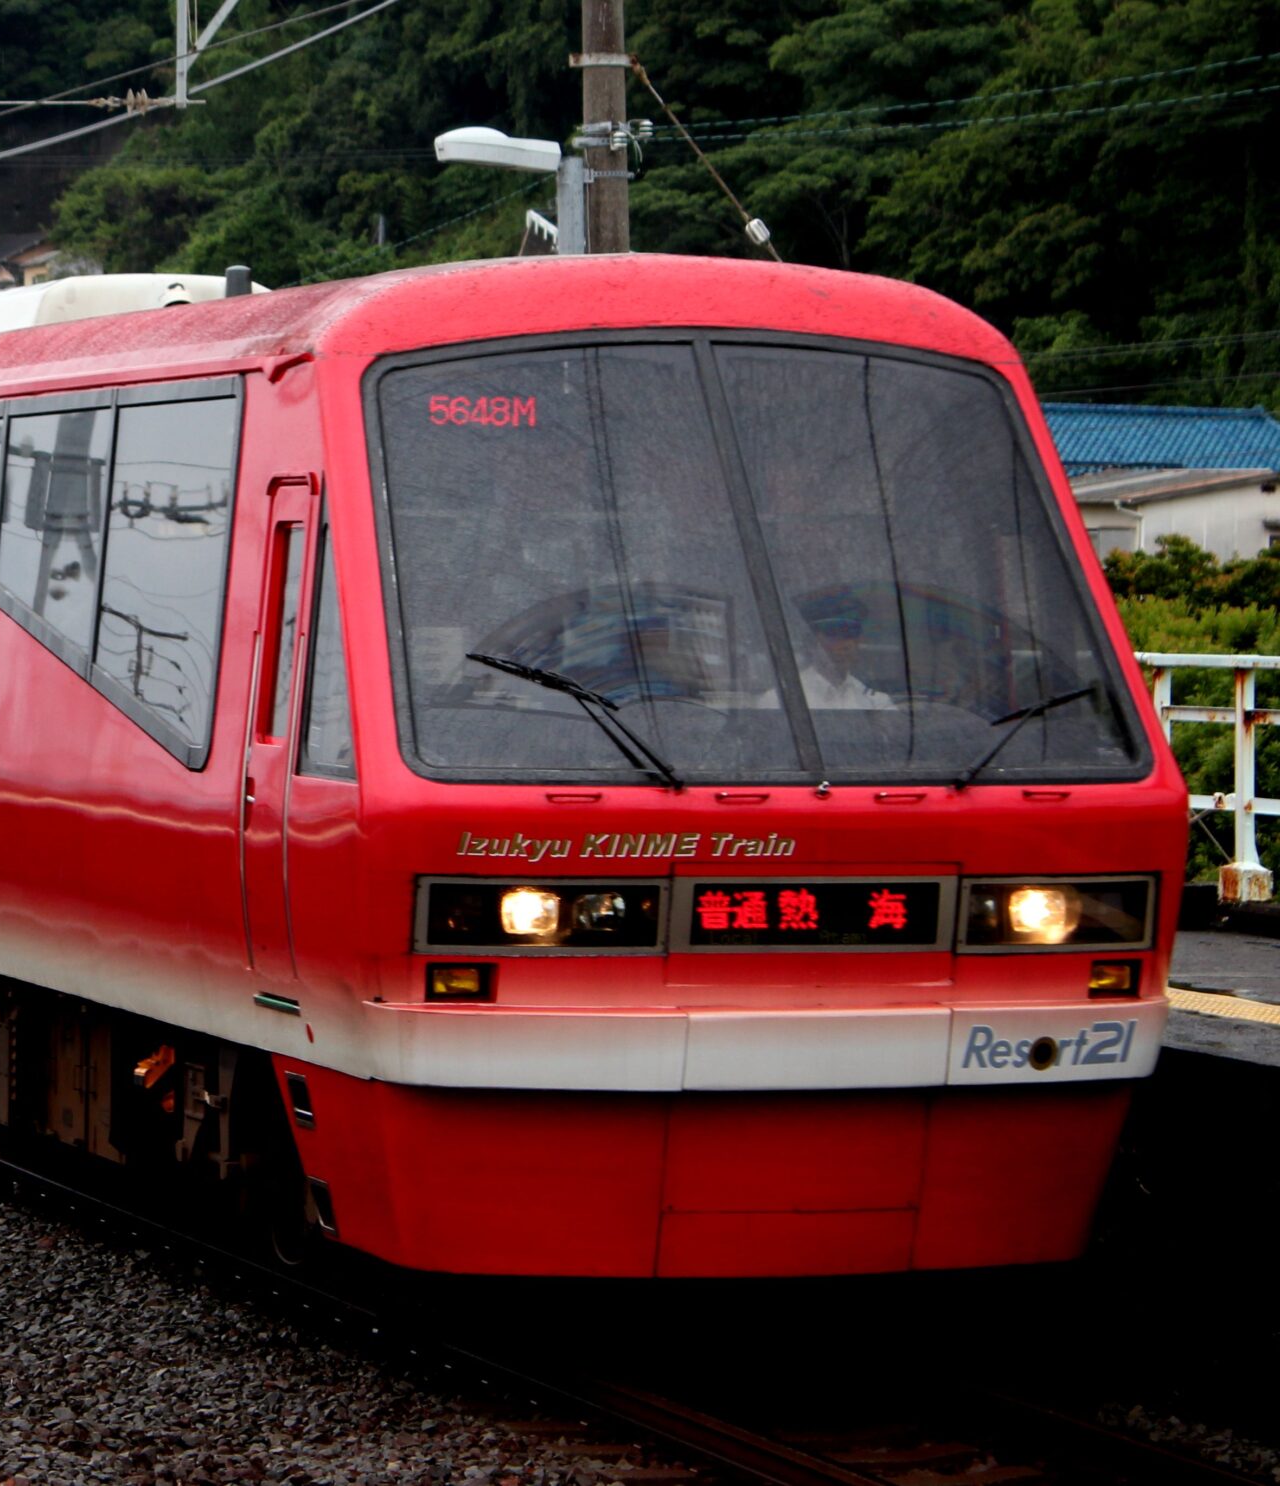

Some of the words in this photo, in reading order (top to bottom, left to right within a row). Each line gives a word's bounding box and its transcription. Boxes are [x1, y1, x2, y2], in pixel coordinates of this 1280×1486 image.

[429, 395, 536, 427] 5648M
[457, 831, 571, 862] Izukyu
[579, 832, 701, 858] KINME
[710, 832, 796, 857] Train
[696, 890, 769, 930] 普通
